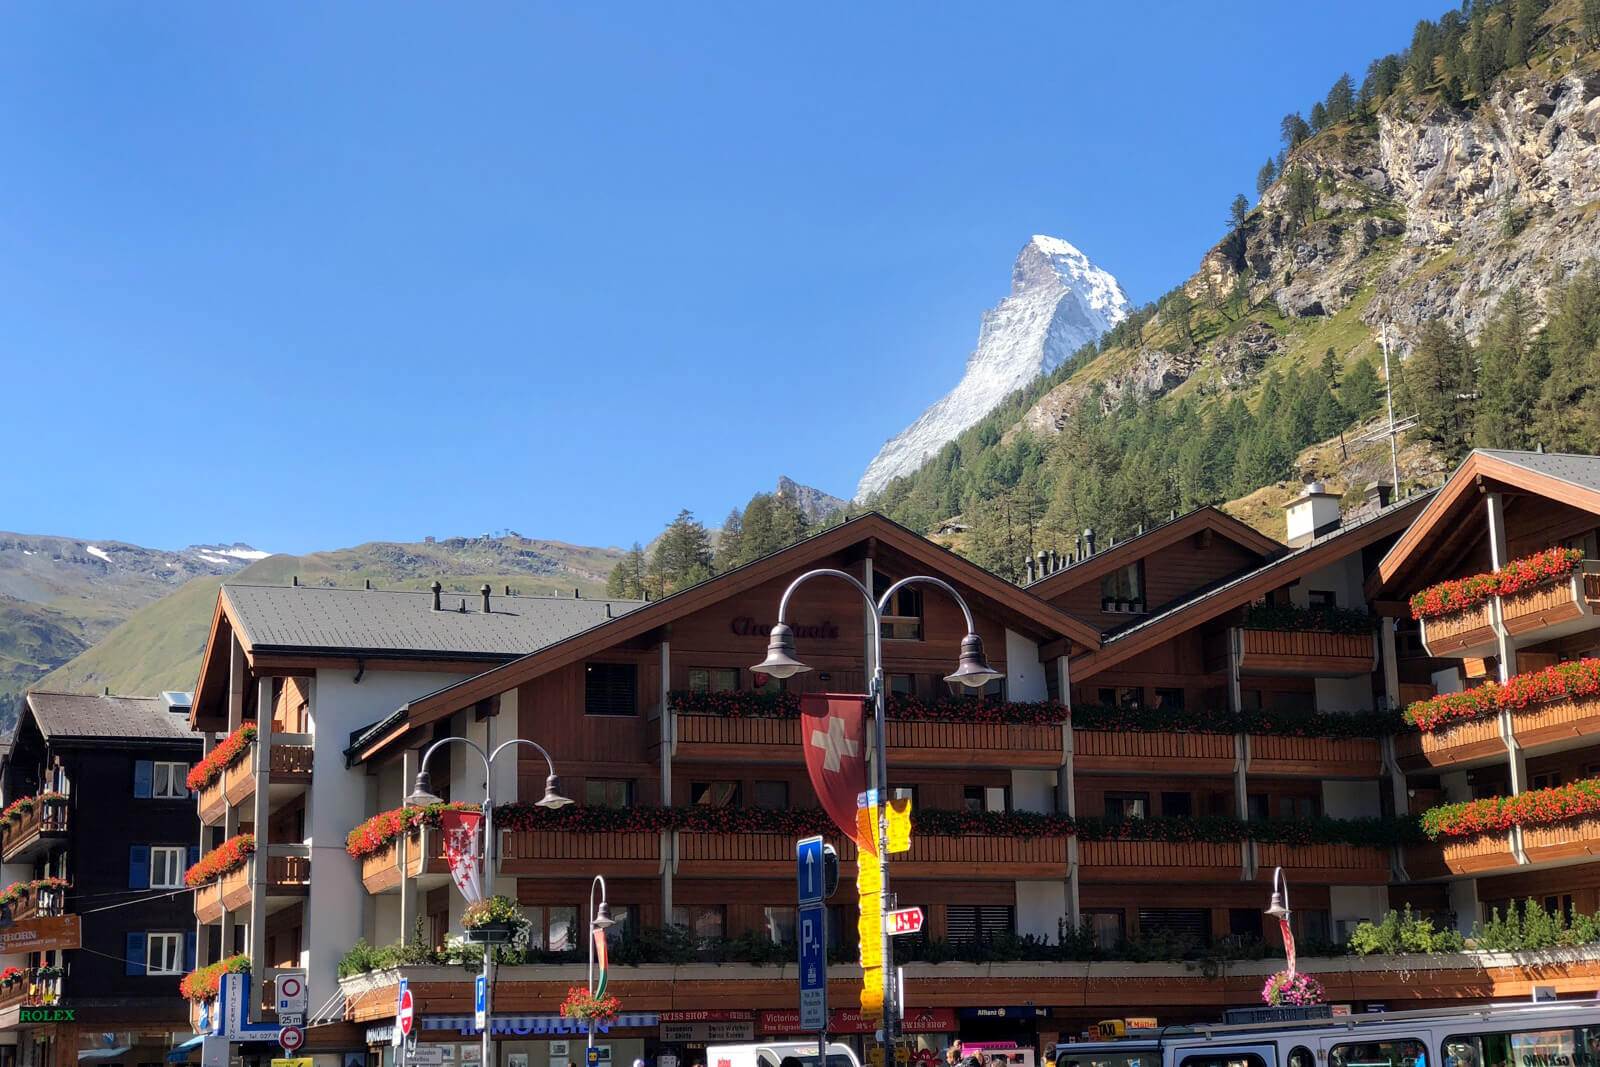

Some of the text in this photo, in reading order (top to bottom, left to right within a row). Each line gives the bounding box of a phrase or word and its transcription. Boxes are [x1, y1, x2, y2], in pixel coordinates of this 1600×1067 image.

[20, 1009, 76, 1022] ROLEX
[685, 1011, 708, 1021] SHOP
[977, 1008, 998, 1017] Allianz
[281, 1016, 292, 1024] 25
[1099, 1023, 1116, 1036] TAXI
